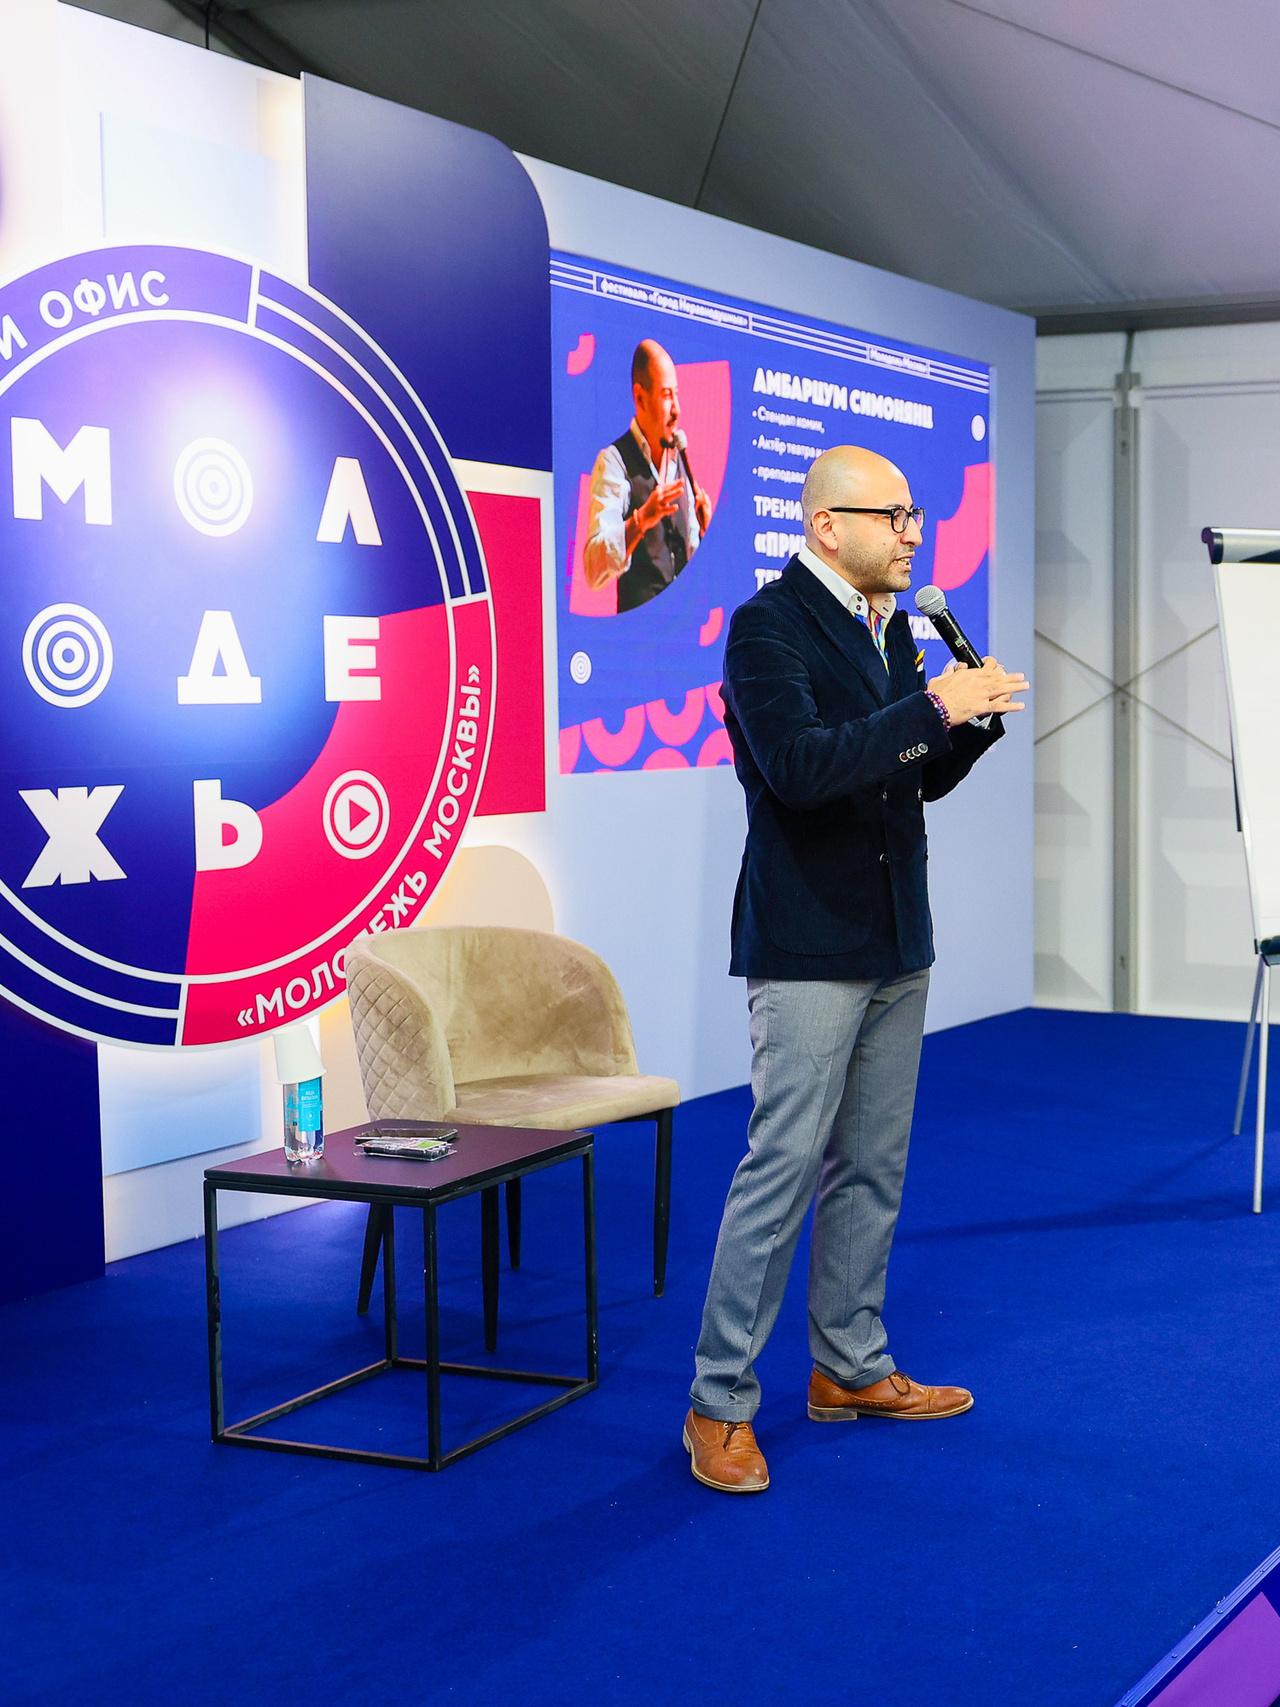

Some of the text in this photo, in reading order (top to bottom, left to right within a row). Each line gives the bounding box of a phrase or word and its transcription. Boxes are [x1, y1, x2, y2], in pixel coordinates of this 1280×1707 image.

[39, 270, 170, 329] ОФИС
[753, 367, 934, 429] АМБАРЦУМ СИМОНЯНЦ
[757, 406, 796, 427] Стендап
[757, 435, 786, 455] Актёр
[753, 495, 803, 521] ТРЕНИ
[423, 664, 481, 860] МОСКВЫ»
